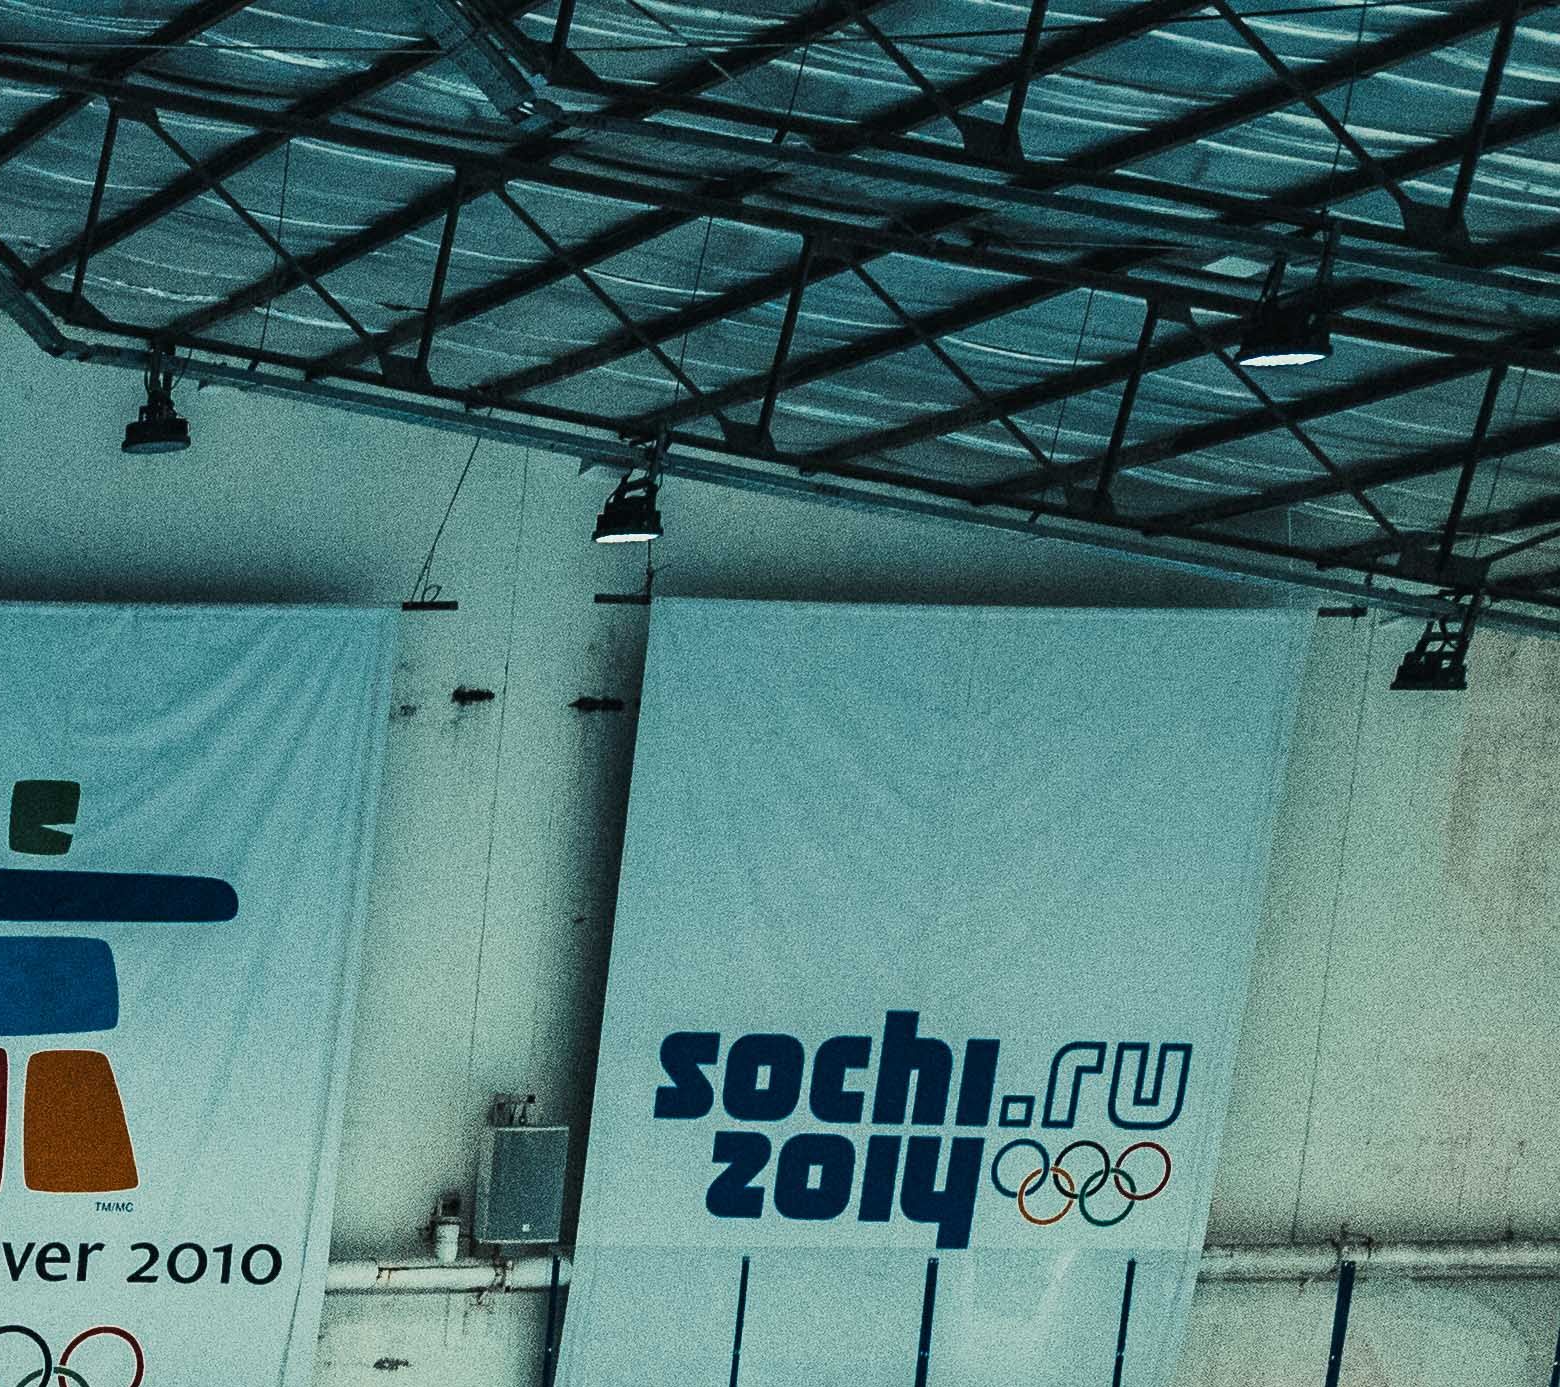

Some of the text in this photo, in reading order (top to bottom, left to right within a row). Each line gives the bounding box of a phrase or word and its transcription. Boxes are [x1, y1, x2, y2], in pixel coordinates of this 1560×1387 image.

[653, 1009, 1193, 1130] sochi.ru
[705, 1130, 985, 1249] 2014
[126, 1241, 283, 1285] 2010
